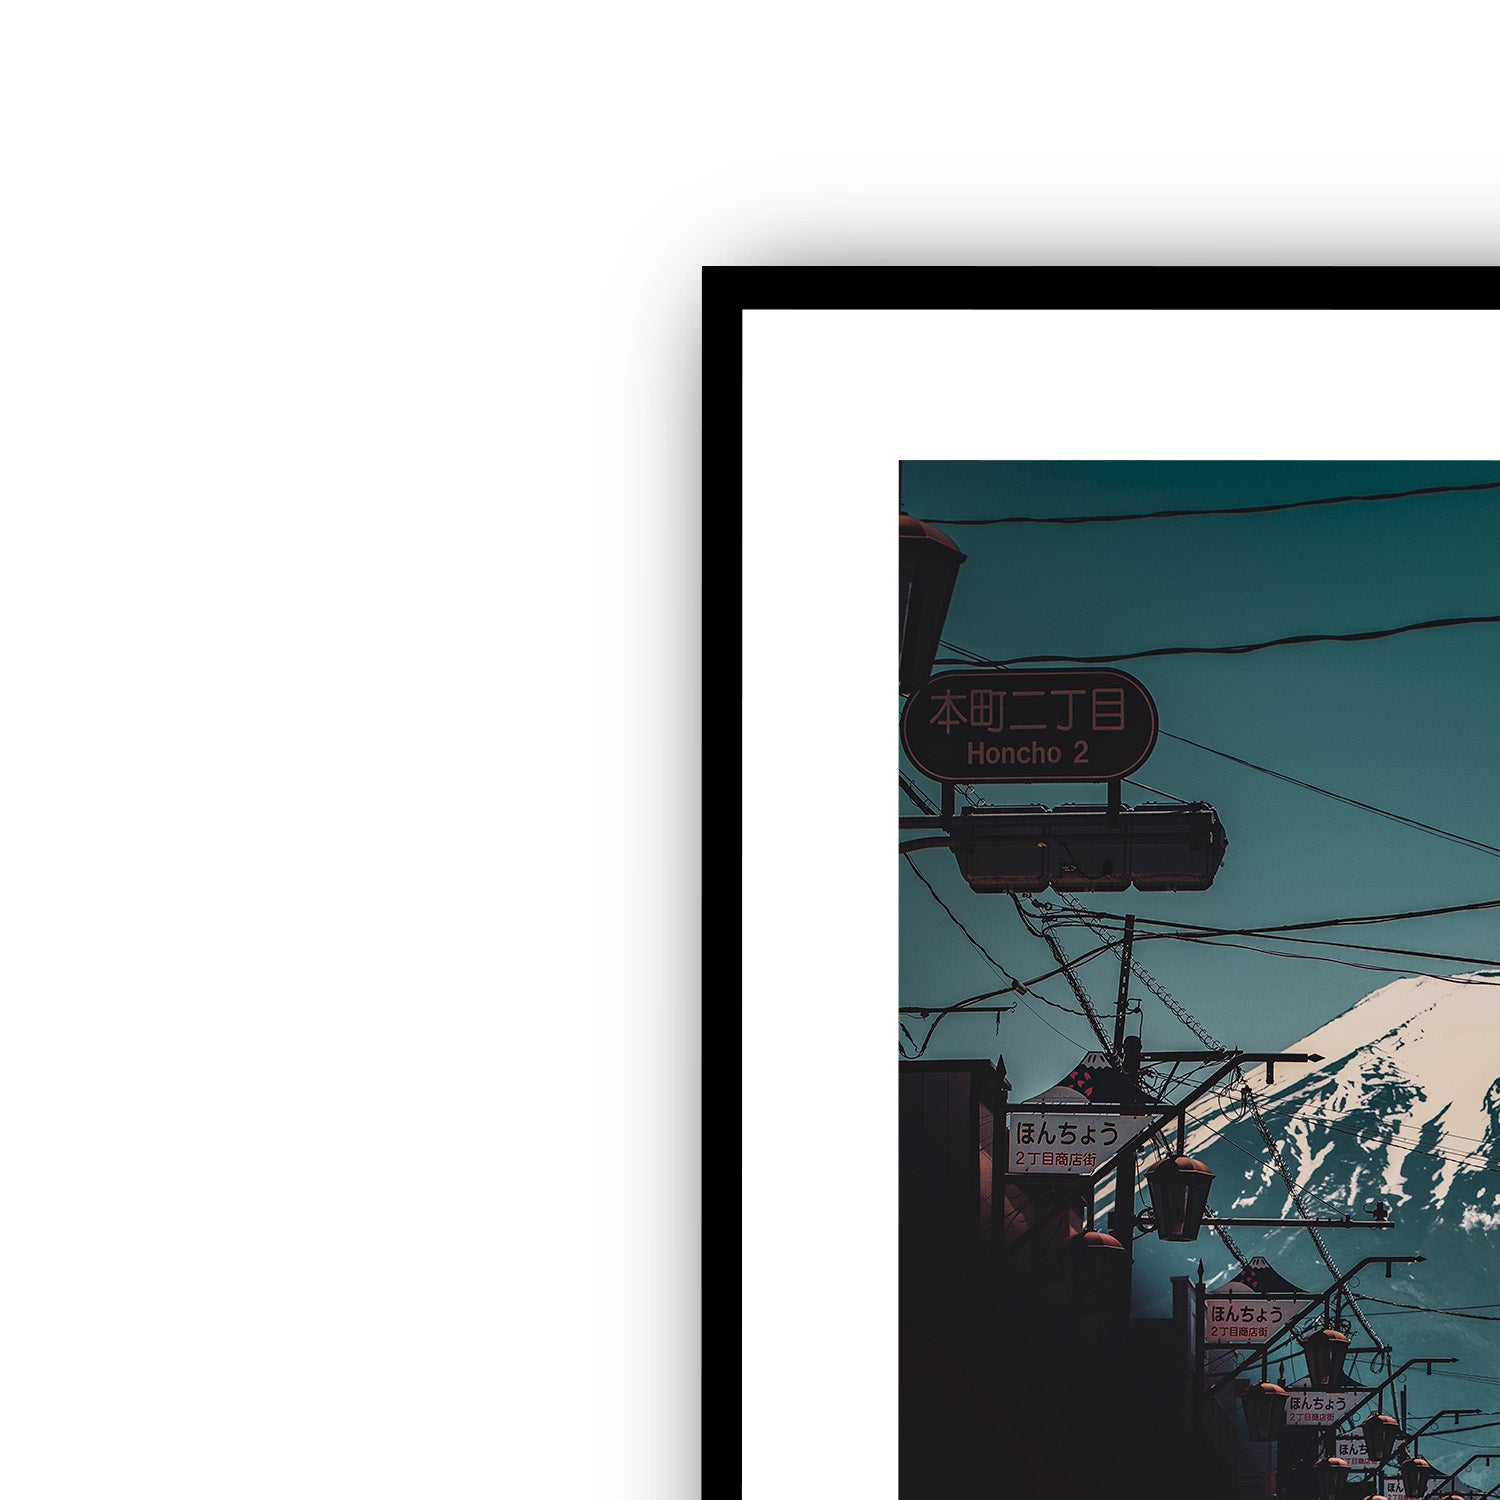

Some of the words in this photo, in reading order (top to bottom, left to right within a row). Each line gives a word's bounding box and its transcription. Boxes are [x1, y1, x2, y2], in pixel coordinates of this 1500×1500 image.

[929, 688, 1125, 734] 本町二丁目
[967, 741, 1062, 764] Honcho
[1073, 740, 1089, 764] 2
[1016, 1121, 1118, 1146] ほんちょう
[1016, 1151, 1097, 1167] 2丁目商店街
[1211, 1305, 1283, 1323] ほんちょう
[1290, 1396, 1346, 1411] ほんちょう
[1339, 1443, 1368, 1455] ほんち
